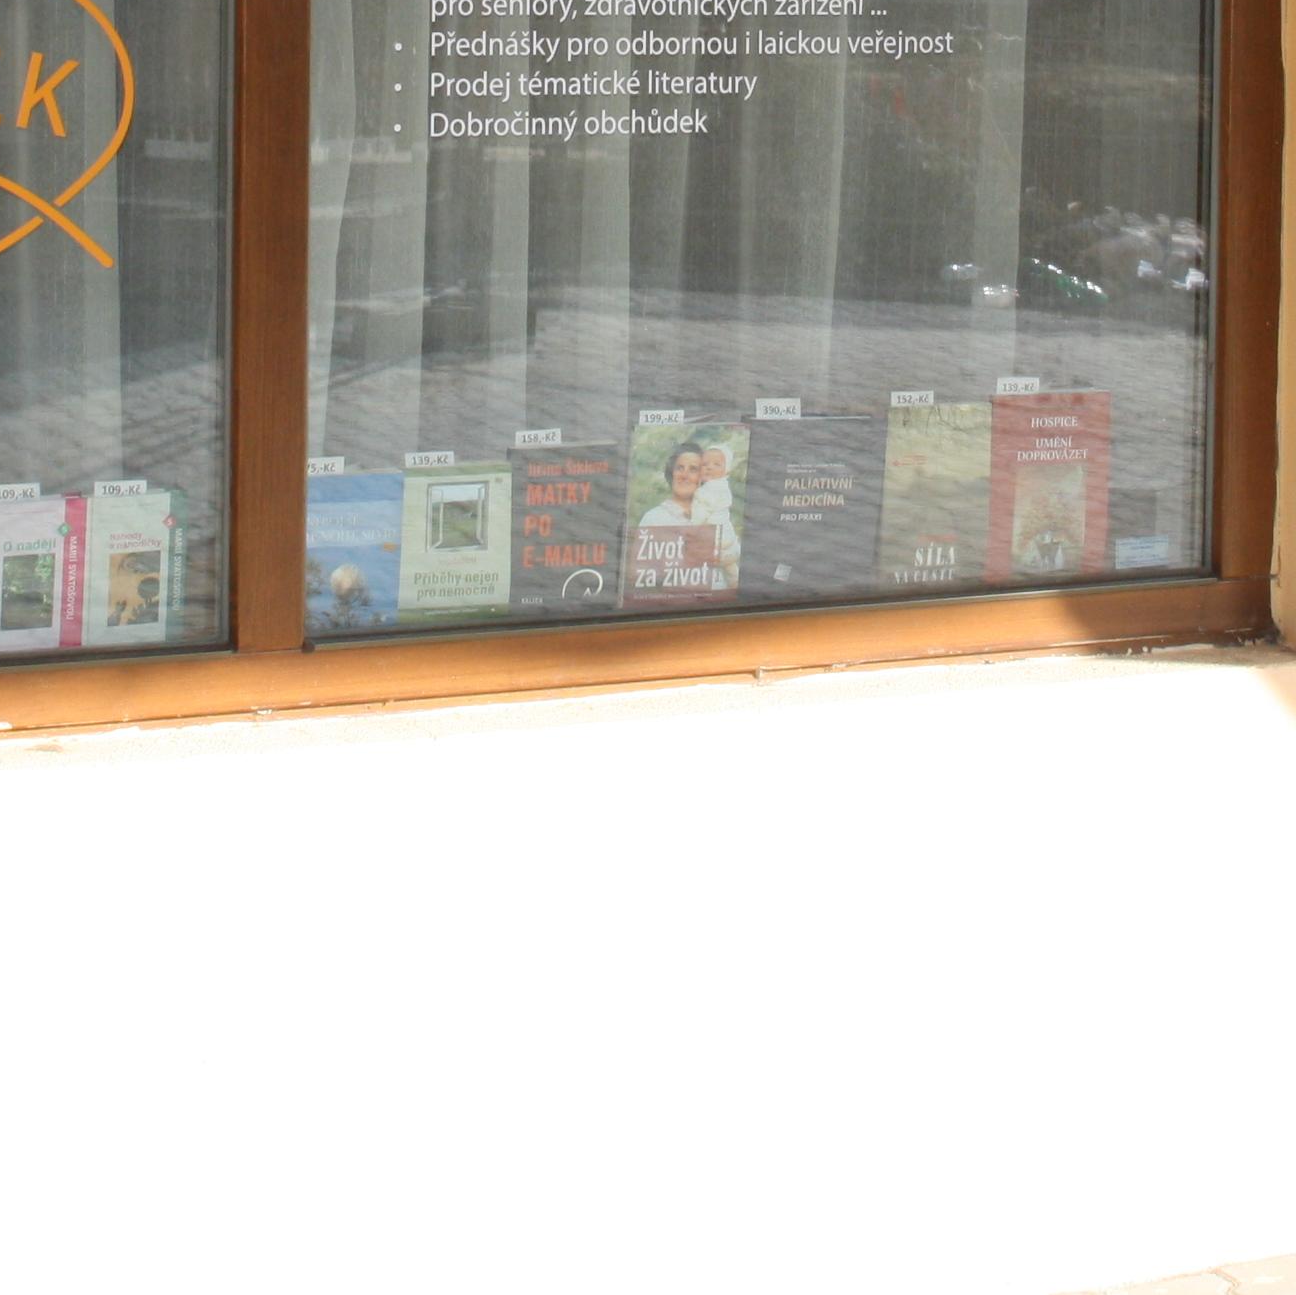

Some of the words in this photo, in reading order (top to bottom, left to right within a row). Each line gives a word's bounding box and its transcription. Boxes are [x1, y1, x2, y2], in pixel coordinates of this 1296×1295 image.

[430, 31, 561, 63] Přednášky
[567, 37, 609, 62] pro
[615, 30, 738, 56] odbornou
[745, 31, 751, 55] i
[757, 30, 841, 55] laickou
[847, 30, 954, 60] veřejnost
[430, 71, 511, 102] Prodej
[518, 71, 640, 97] tématické
[647, 70, 758, 100] literatury
[429, 109, 579, 143] Dobročinný
[583, 108, 709, 135] obchůdek
[644, 412, 680, 424] 199,-Kč
[1030, 415, 1079, 429] HOSPICE
[1035, 436, 1073, 449] UMĚNÍ
[411, 454, 449, 466] 139,-Kč
[1016, 448, 1088, 462] DOPROVÁZET
[101, 483, 141, 496] 109,-Kč
[783, 475, 854, 490] PALIATIVNÍ
[526, 481, 592, 507] MATKY
[782, 492, 845, 507] MEDICÍNA
[523, 513, 553, 538] PO
[636, 529, 685, 561] Život
[522, 544, 608, 568] E-MAILU
[413, 570, 462, 587] Příběhy
[464, 570, 499, 586] nejen
[635, 569, 657, 588] za
[662, 561, 709, 587] život
[416, 587, 437, 601] pro
